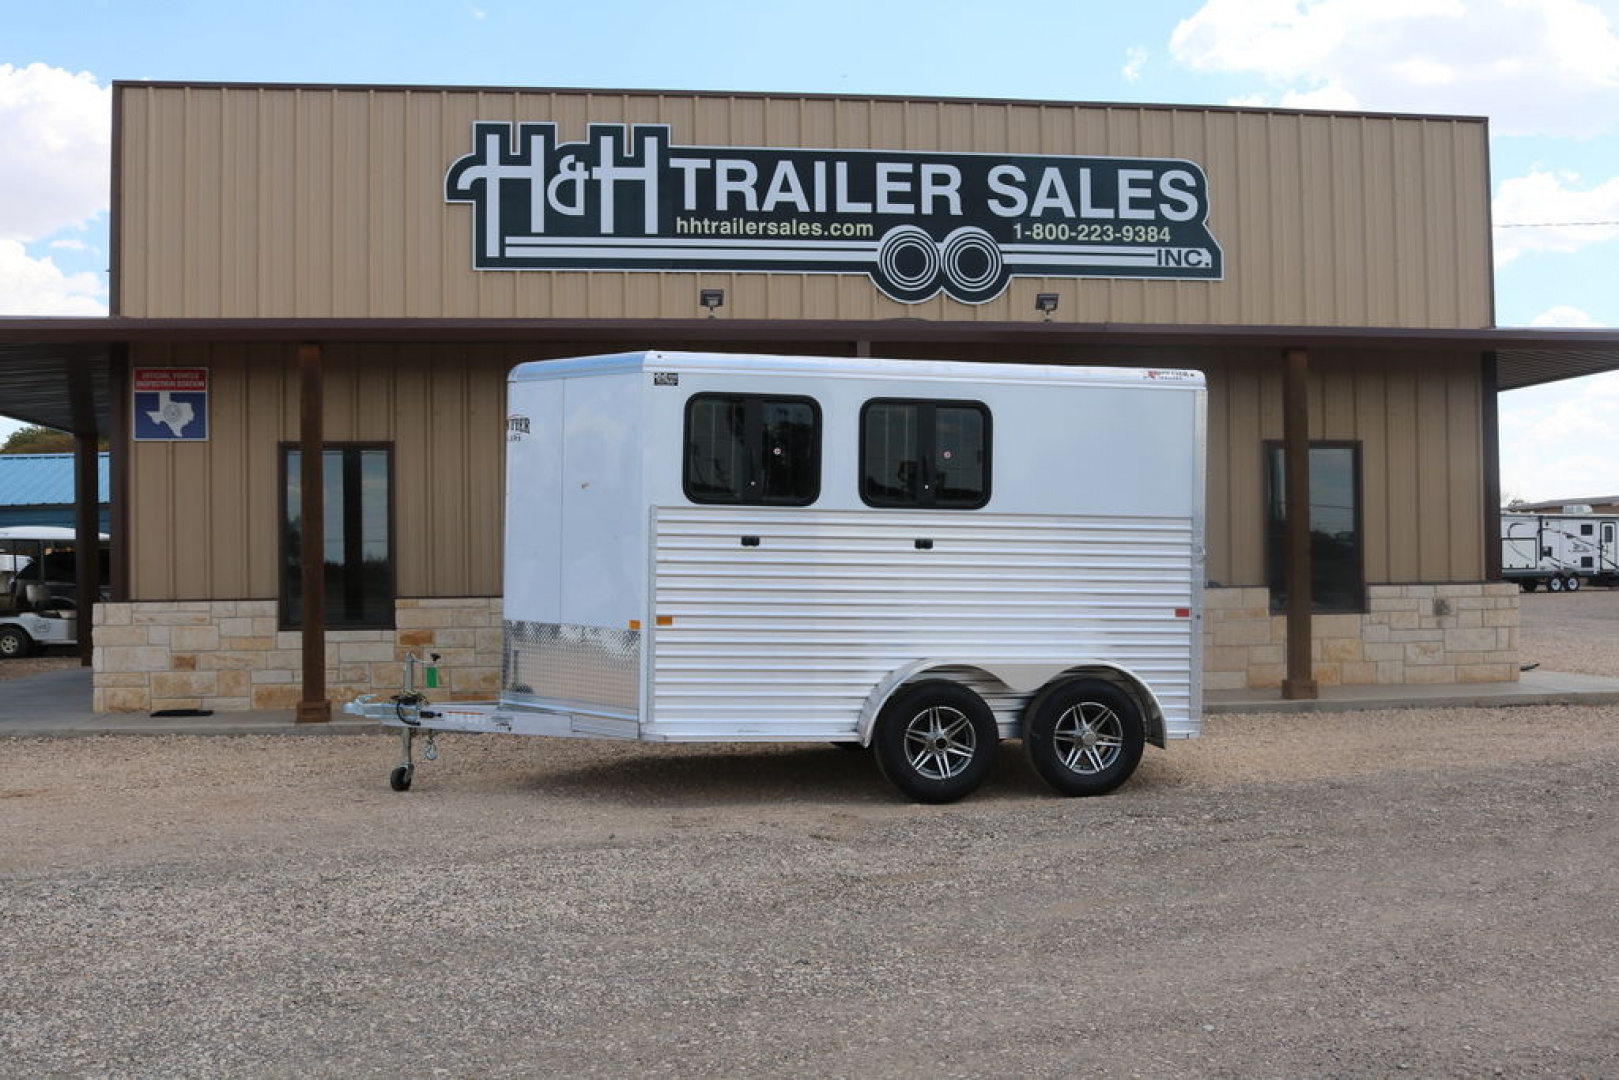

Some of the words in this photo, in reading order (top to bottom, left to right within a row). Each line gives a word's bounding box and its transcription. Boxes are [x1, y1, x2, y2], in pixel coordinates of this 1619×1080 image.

[456, 133, 658, 257] H&H
[669, 157, 963, 216] TRAILER
[987, 164, 1199, 221] SALES
[676, 216, 874, 237] hhtrailersales.com
[1012, 223, 1171, 243] 1-800-223-9384
[1156, 249, 1211, 268] INC.
